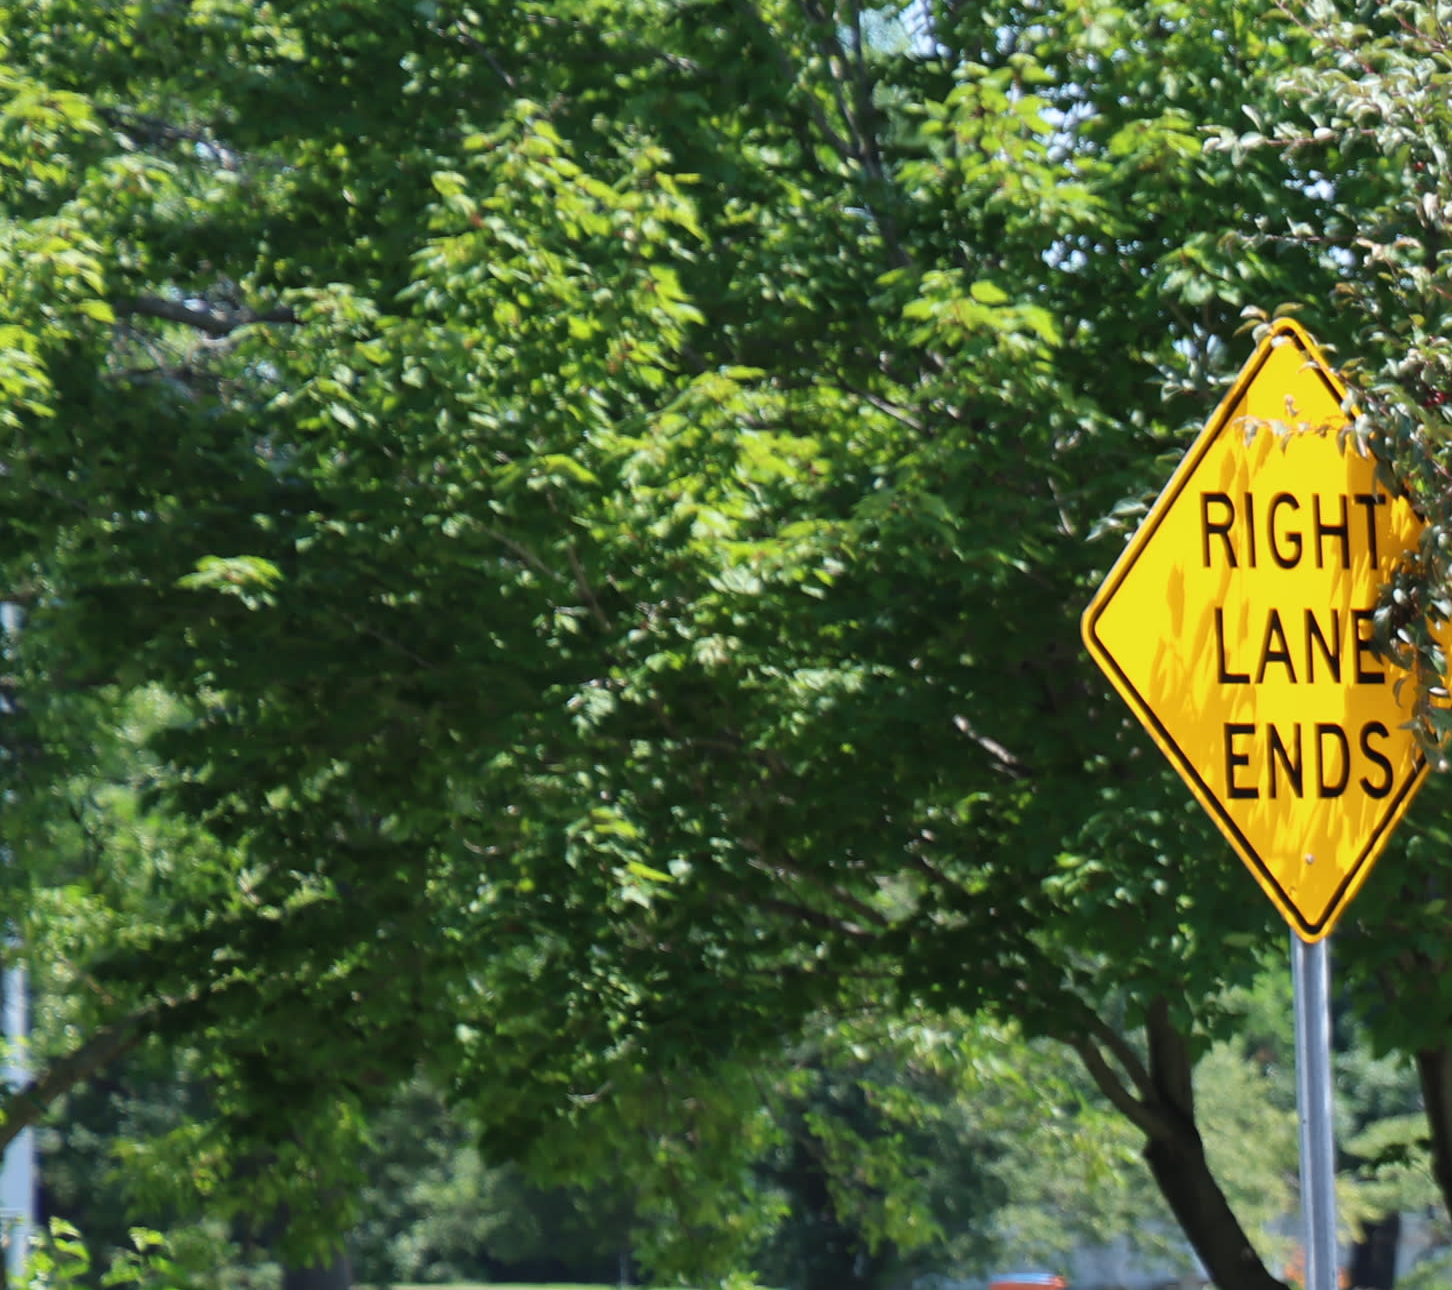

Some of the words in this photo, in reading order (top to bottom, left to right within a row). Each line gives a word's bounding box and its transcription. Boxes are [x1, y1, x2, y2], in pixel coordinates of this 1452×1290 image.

[1200, 491, 1387, 570] RIGHT
[1214, 607, 1386, 685] LANE
[1223, 721, 1394, 800] ENDS
